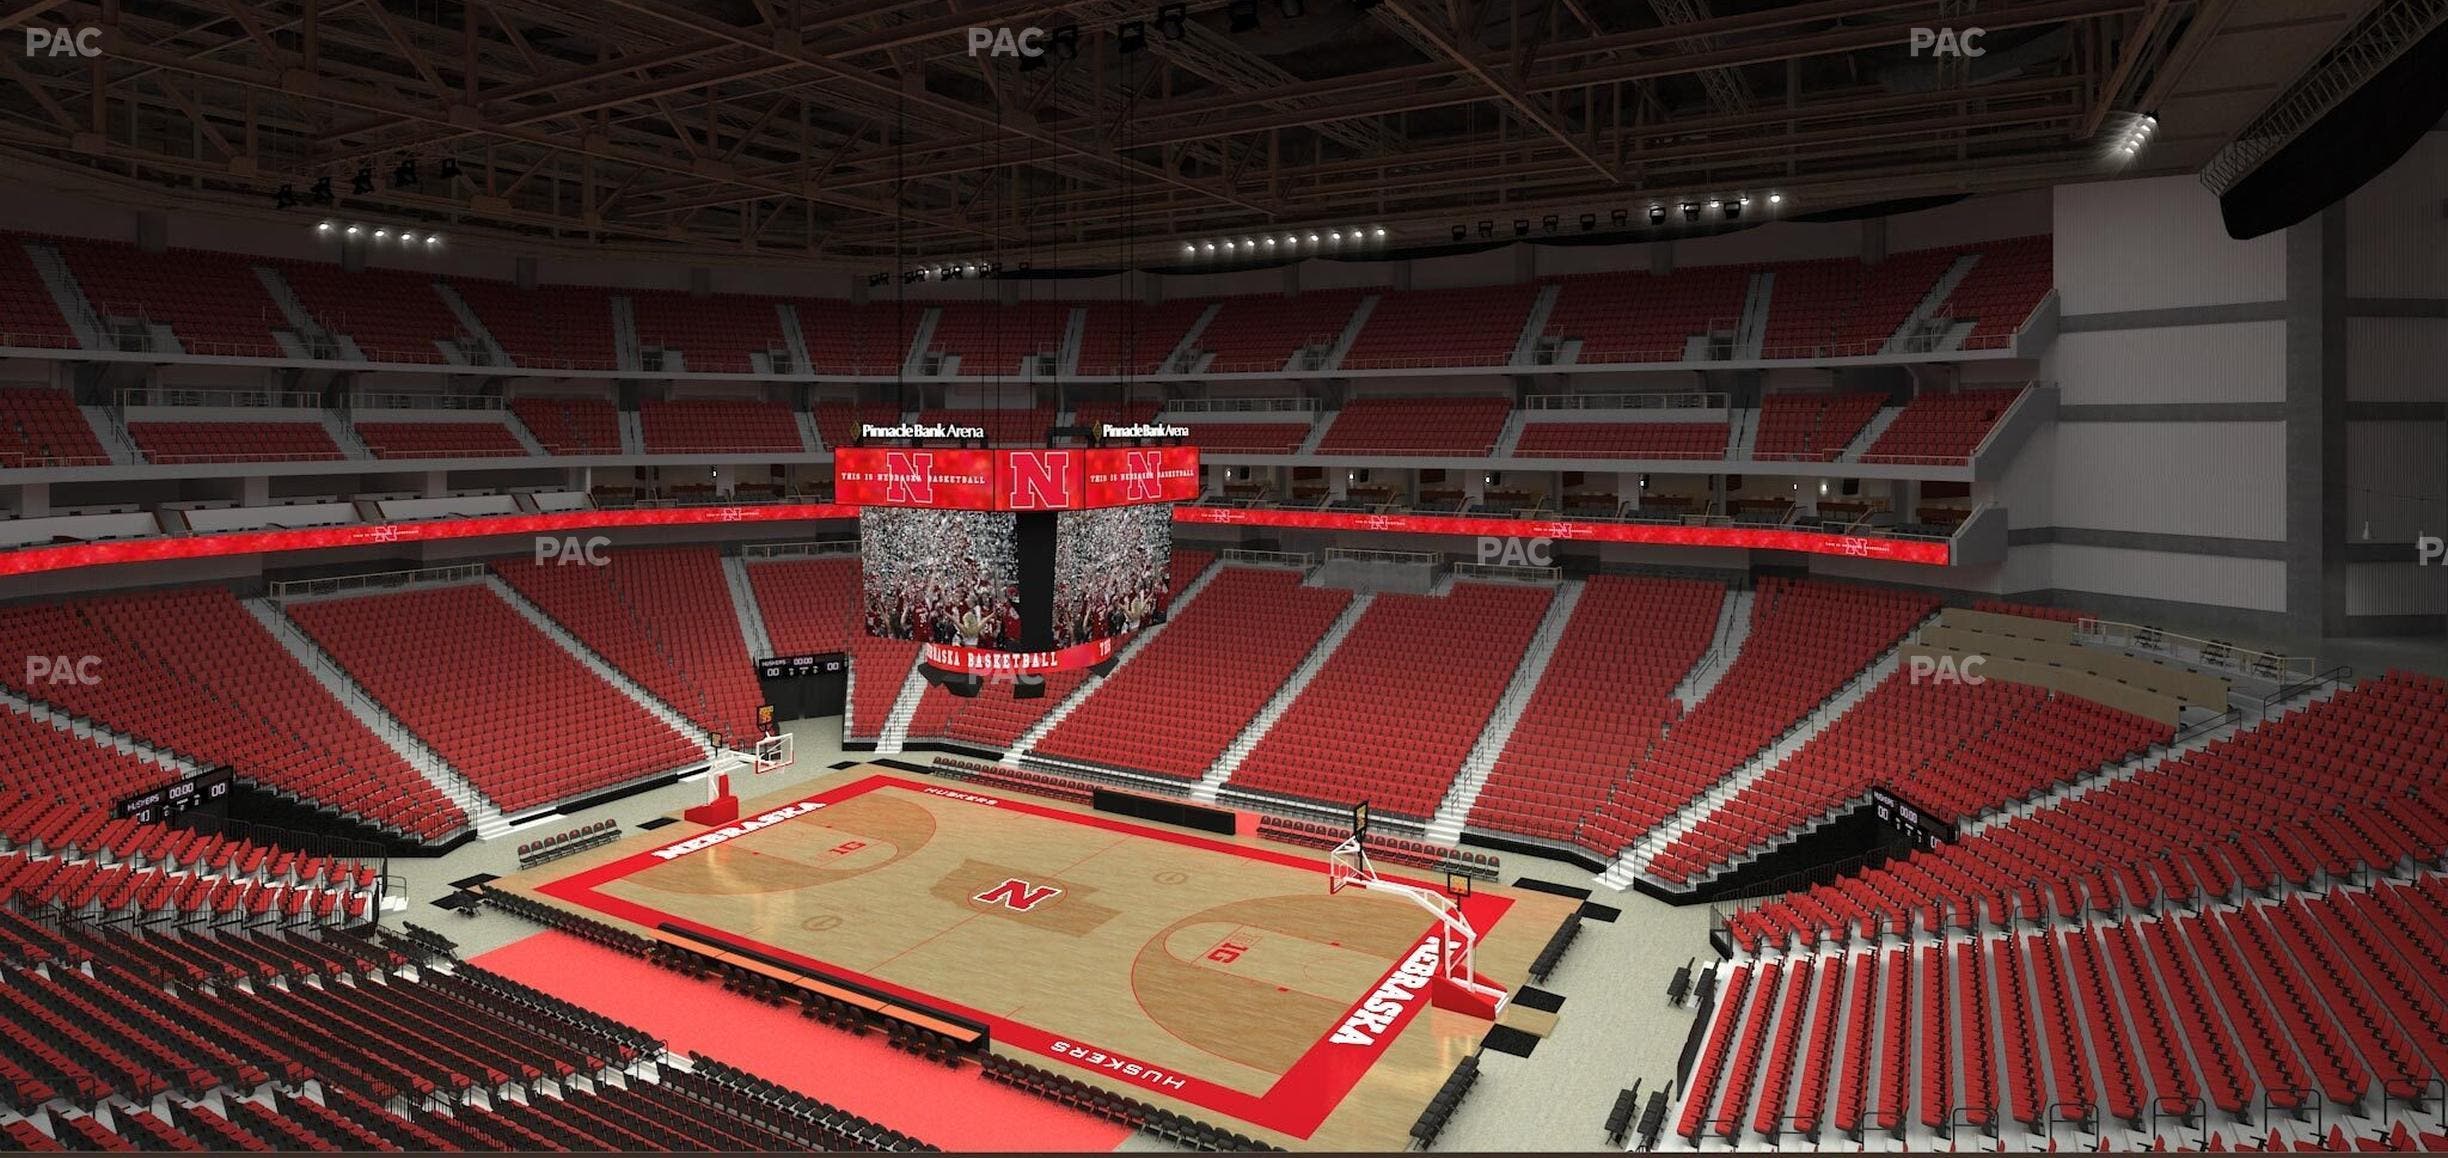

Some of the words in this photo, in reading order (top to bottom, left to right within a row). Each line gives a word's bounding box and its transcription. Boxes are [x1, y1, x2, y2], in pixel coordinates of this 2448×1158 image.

[863, 424, 913, 438] Pinnacle
[914, 424, 946, 438] Bank
[947, 425, 984, 438] Arena
[1103, 424, 1143, 438] Pinnacle
[1143, 424, 1166, 437] Bank
[1165, 425, 1189, 437] Arena
[841, 472, 861, 481] THIS
[864, 473, 873, 481] IS
[928, 474, 985, 485] BASKETBALL
[887, 452, 932, 504] N
[1010, 452, 1068, 509] N
[1128, 451, 1161, 500] N
[767, 668, 779, 676] 00
[967, 652, 1057, 669] BASKETBALL
[211, 782, 226, 798] 00
[651, 801, 828, 861] NEBRASKA
[973, 878, 1062, 912] N
[1050, 1041, 1186, 1090] HUSKERS
